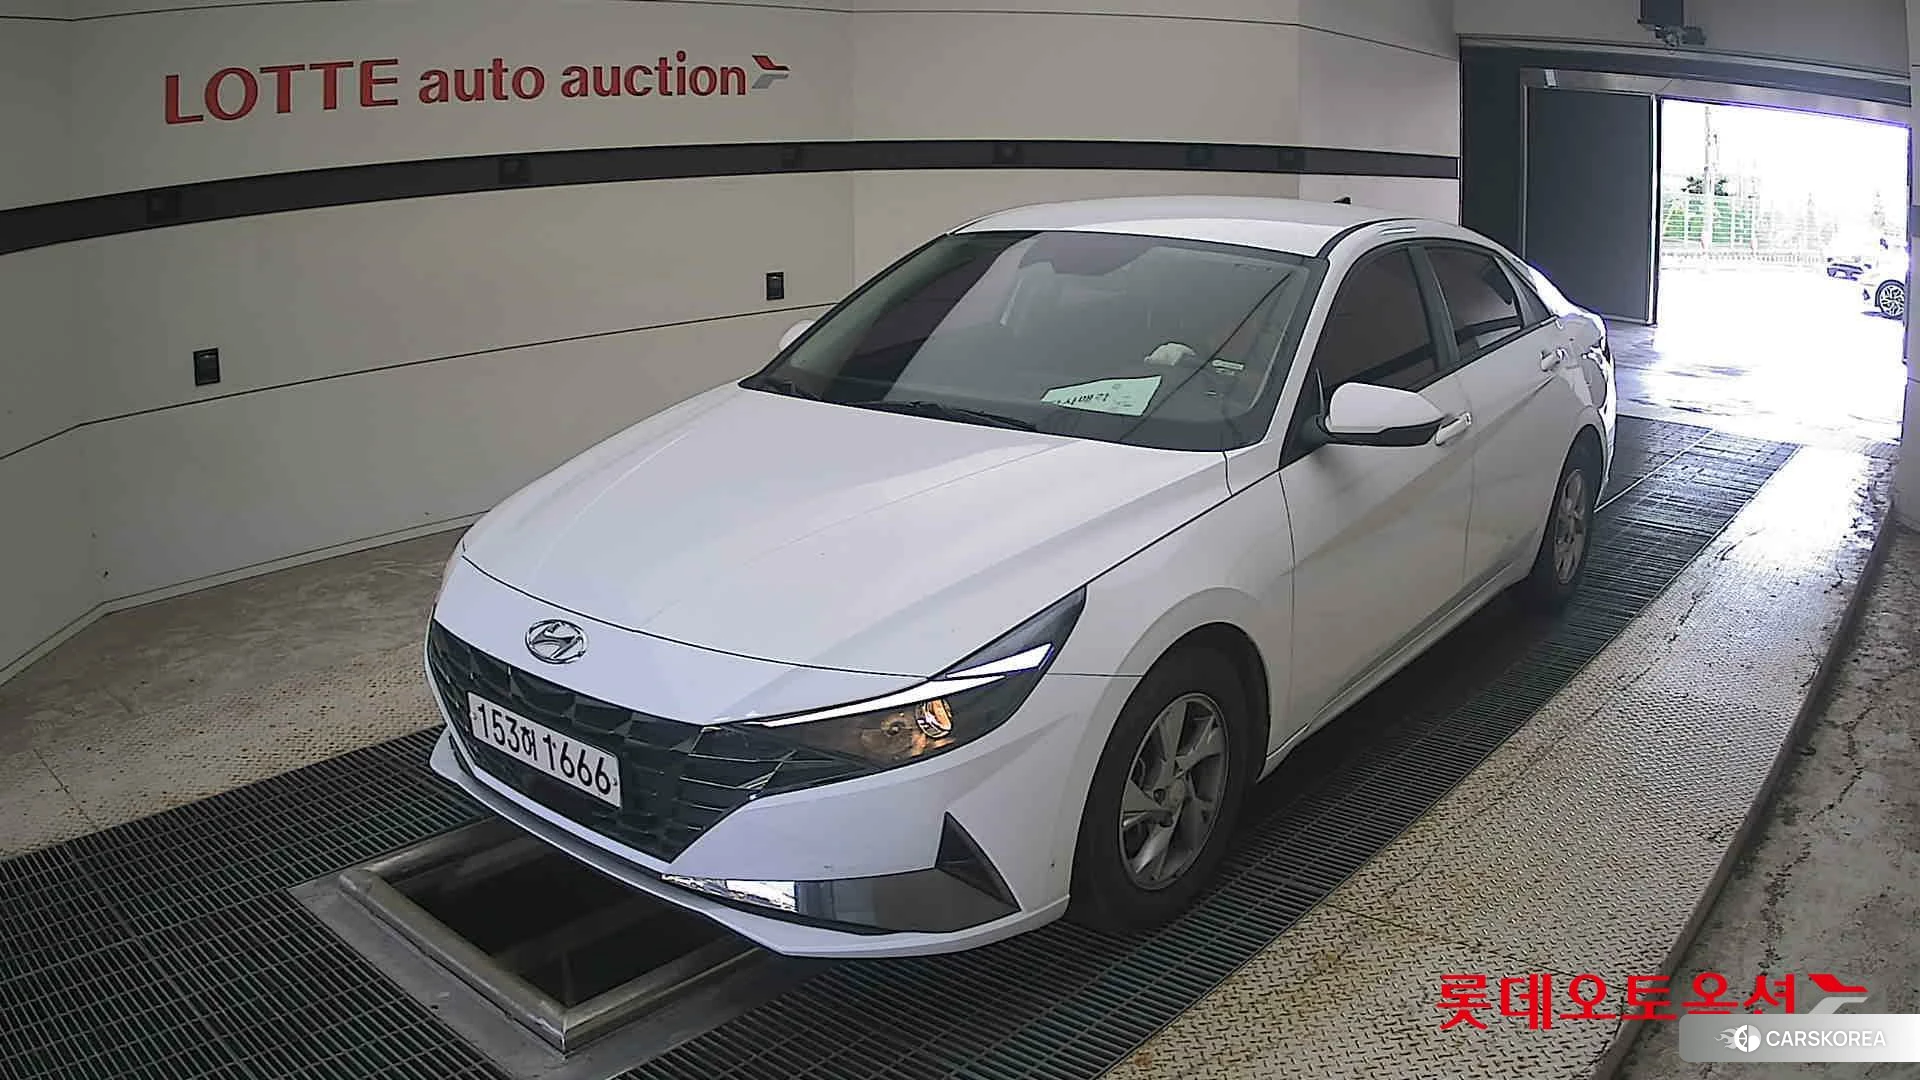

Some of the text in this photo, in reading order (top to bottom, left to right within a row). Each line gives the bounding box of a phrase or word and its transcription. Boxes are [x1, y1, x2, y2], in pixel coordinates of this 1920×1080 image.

[165, 50, 747, 125] LOTTE auto auction
